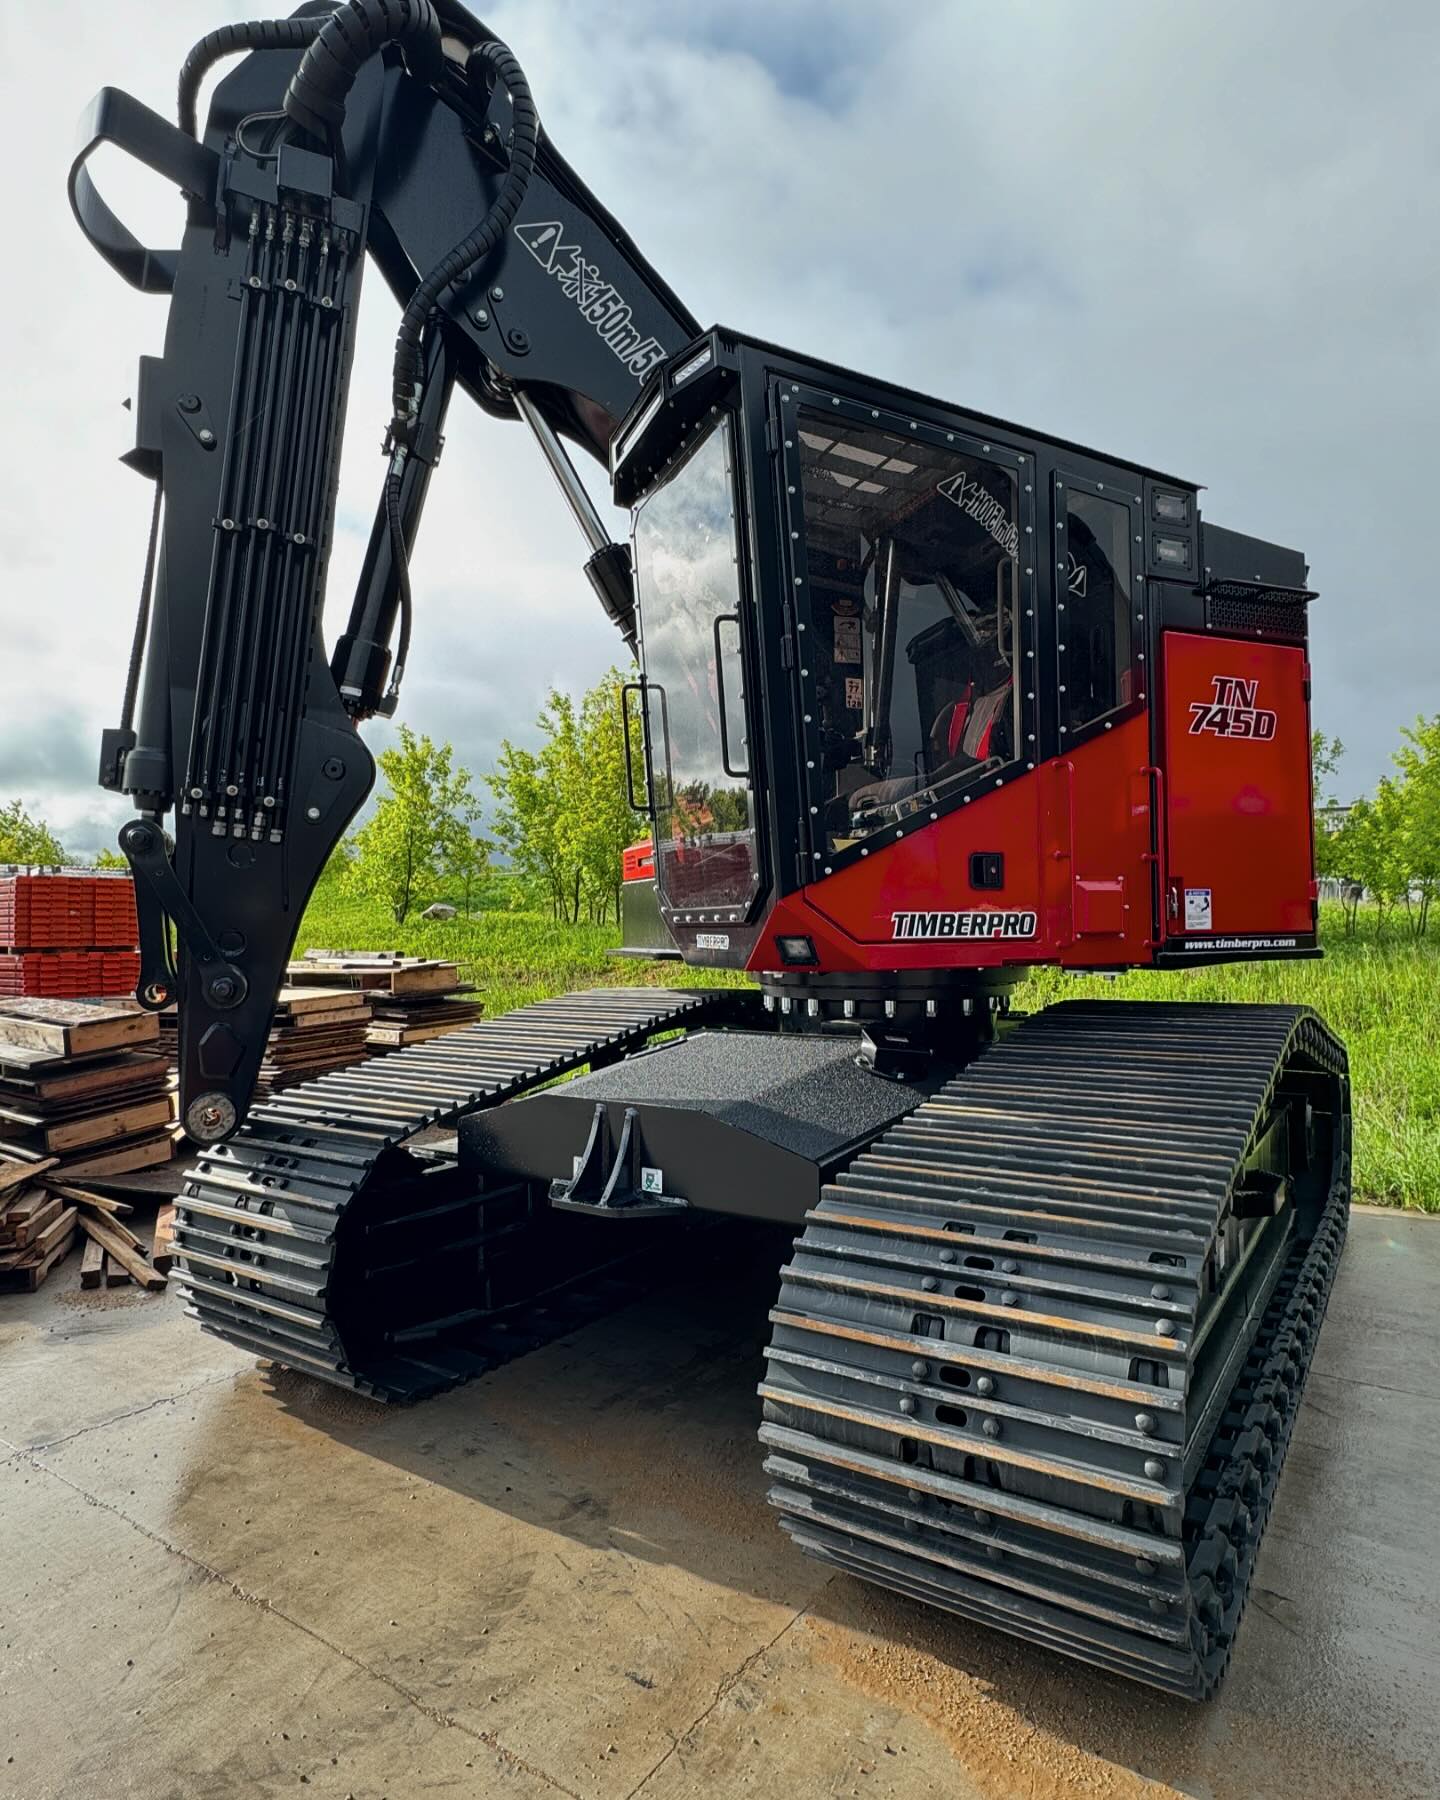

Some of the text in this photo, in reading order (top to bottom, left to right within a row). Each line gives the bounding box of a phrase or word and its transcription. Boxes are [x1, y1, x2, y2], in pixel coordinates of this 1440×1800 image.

[1212, 675, 1258, 708] TN
[1189, 703, 1277, 740] 745D
[891, 911, 1037, 939] TIMBERPRO
[1185, 938, 1296, 950] www.timberpro.com
